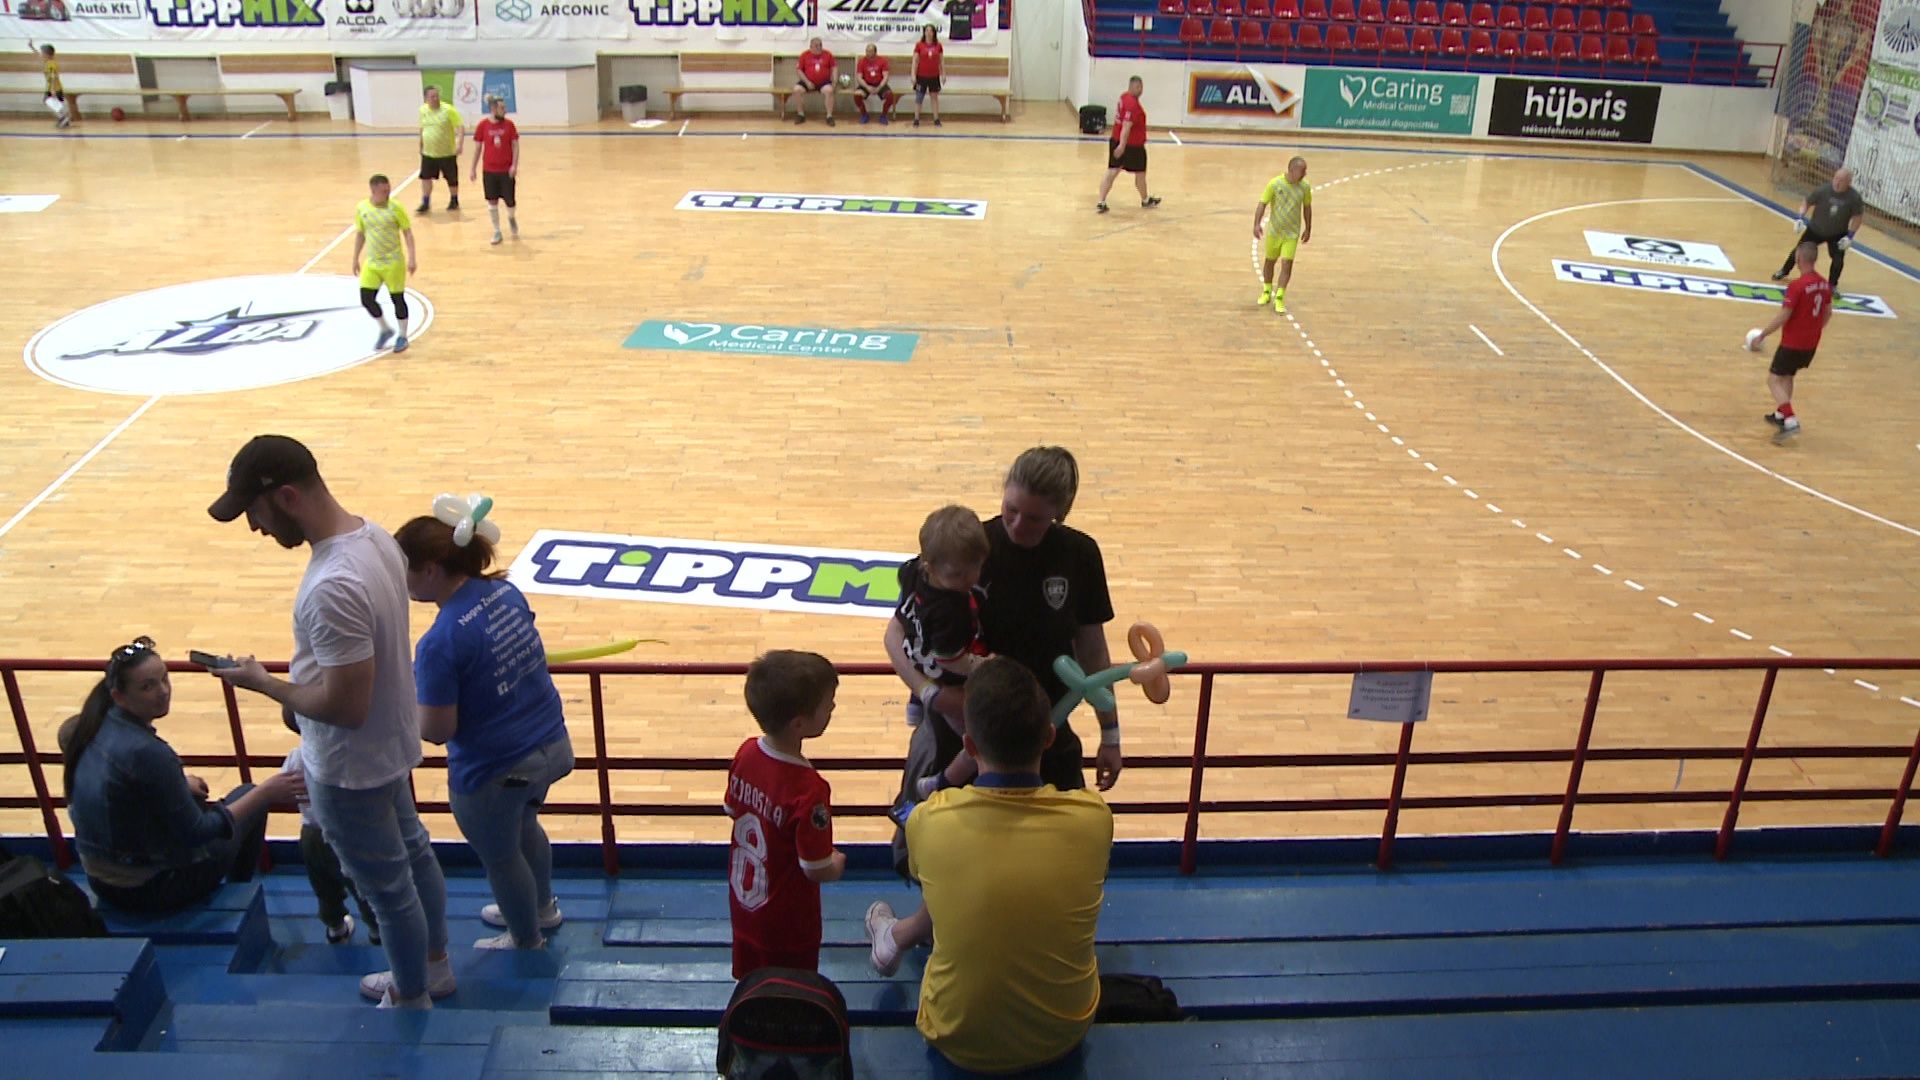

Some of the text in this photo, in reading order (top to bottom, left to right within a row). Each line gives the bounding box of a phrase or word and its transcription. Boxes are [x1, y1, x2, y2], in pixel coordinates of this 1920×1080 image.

[111, 2, 131, 14] Kft
[540, 4, 609, 16] ARCONIC
[336, 15, 387, 25] ALCOA
[1226, 84, 1270, 104] AL
[1371, 76, 1444, 105] Caring
[1363, 100, 1427, 112] Medical Center
[731, 325, 890, 350] Caring
[709, 340, 783, 350] Medical
[788, 344, 851, 354] Center
[532, 539, 904, 608] TiPPM
[730, 811, 769, 913] 8
